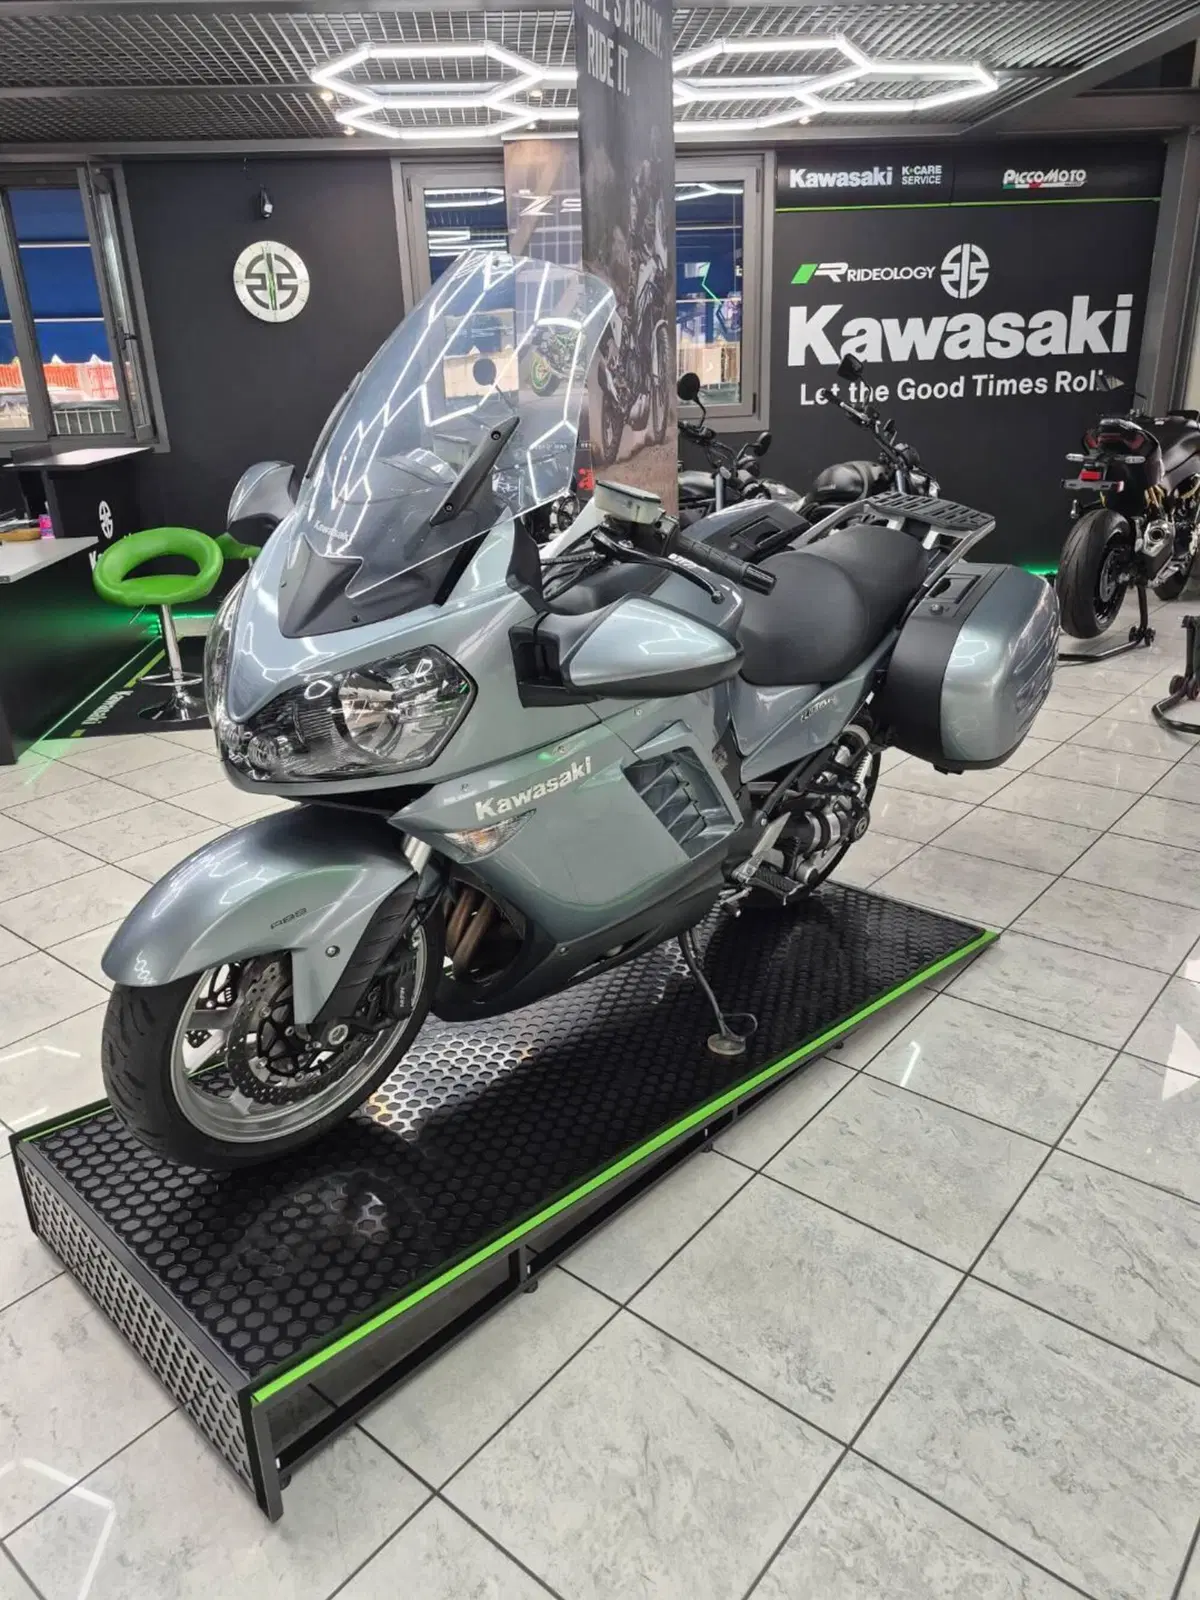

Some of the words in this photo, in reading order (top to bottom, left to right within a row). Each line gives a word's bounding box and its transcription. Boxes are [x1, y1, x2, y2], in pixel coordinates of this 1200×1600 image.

[587, 24, 615, 88] RIDE
[618, 45, 630, 97] IT.
[789, 167, 894, 188] Kawasaki
[902, 175, 942, 185] SERVICE
[847, 266, 936, 282] RIDEOLOGY
[787, 294, 1134, 367] Kawasaki
[800, 383, 841, 406] Let
[848, 381, 890, 403] the
[896, 375, 965, 400] Good
[971, 371, 1049, 396] Times
[1054, 369, 1104, 393] Rol
[475, 756, 592, 821] Kawasaki
